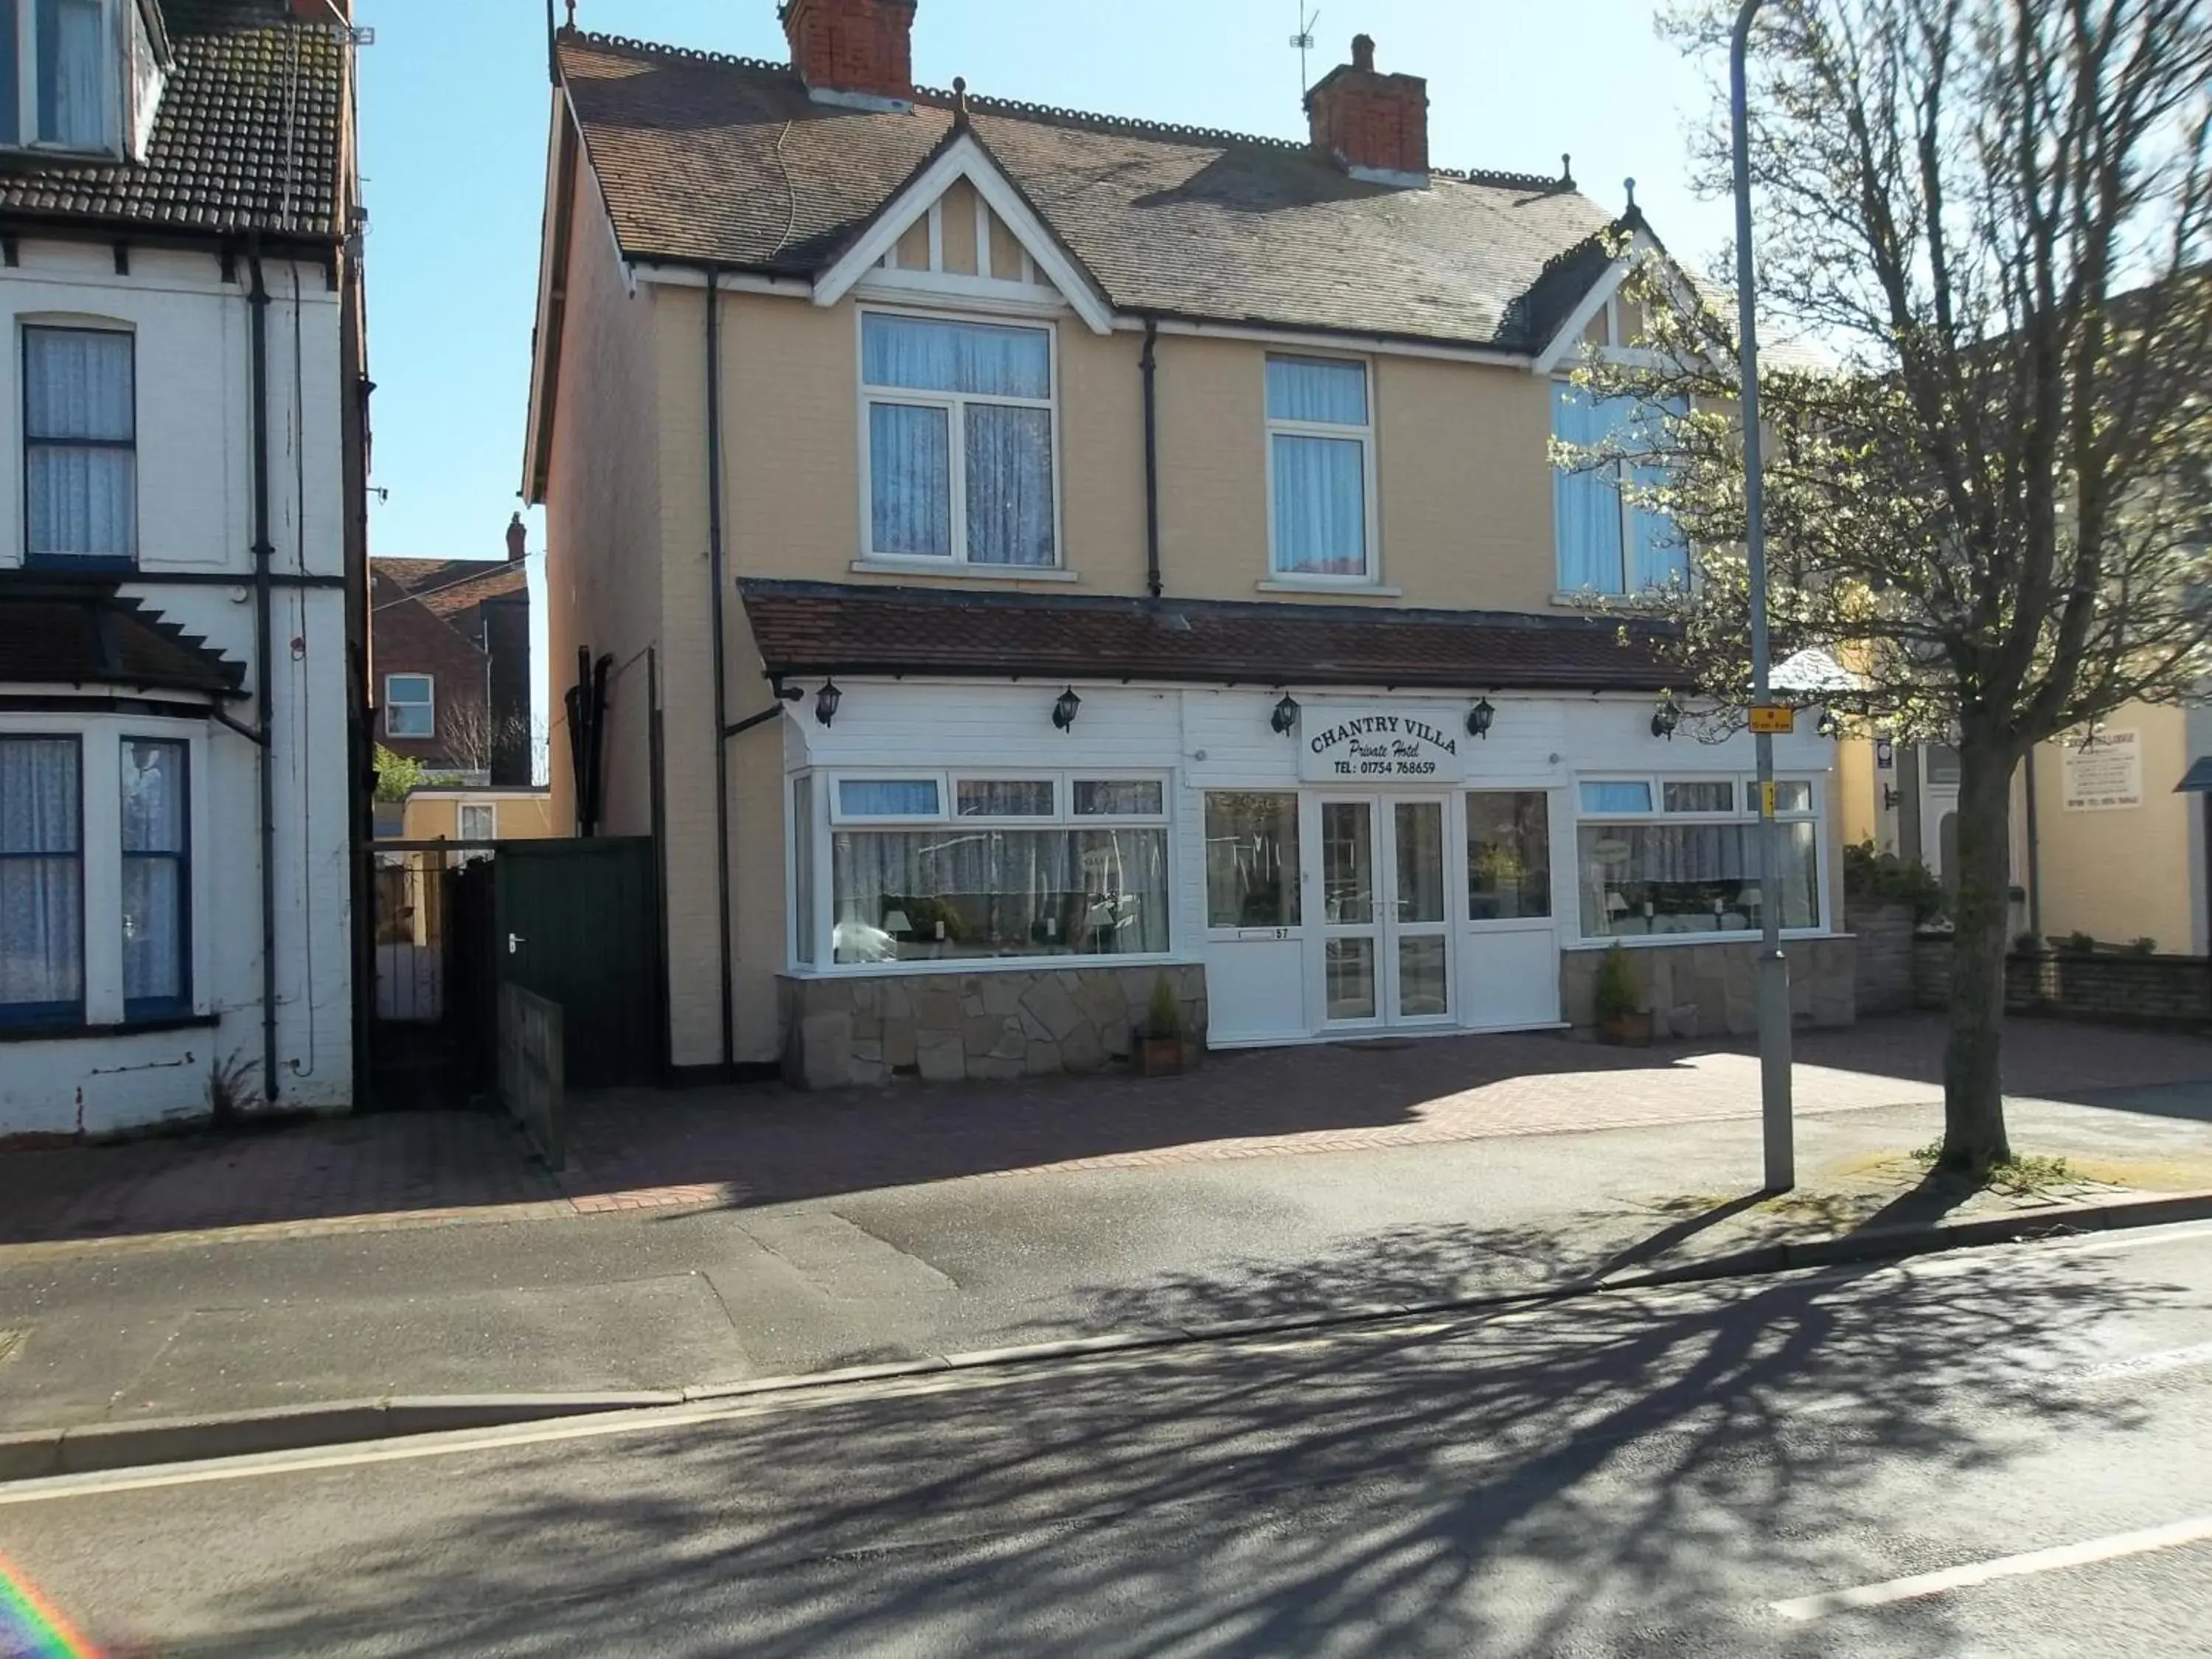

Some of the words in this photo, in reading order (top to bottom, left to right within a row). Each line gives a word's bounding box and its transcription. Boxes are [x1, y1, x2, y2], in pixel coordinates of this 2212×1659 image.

[1311, 716, 1399, 754] CHANTRY
[1404, 719, 1457, 756] VILLA
[1349, 739, 1388, 758] Private
[1391, 739, 1420, 757] Hotel
[1334, 761, 1357, 774] TEL:
[1360, 762, 1392, 774] 01754
[1396, 761, 1436, 774] 768659
[1276, 928, 1287, 939] 57
